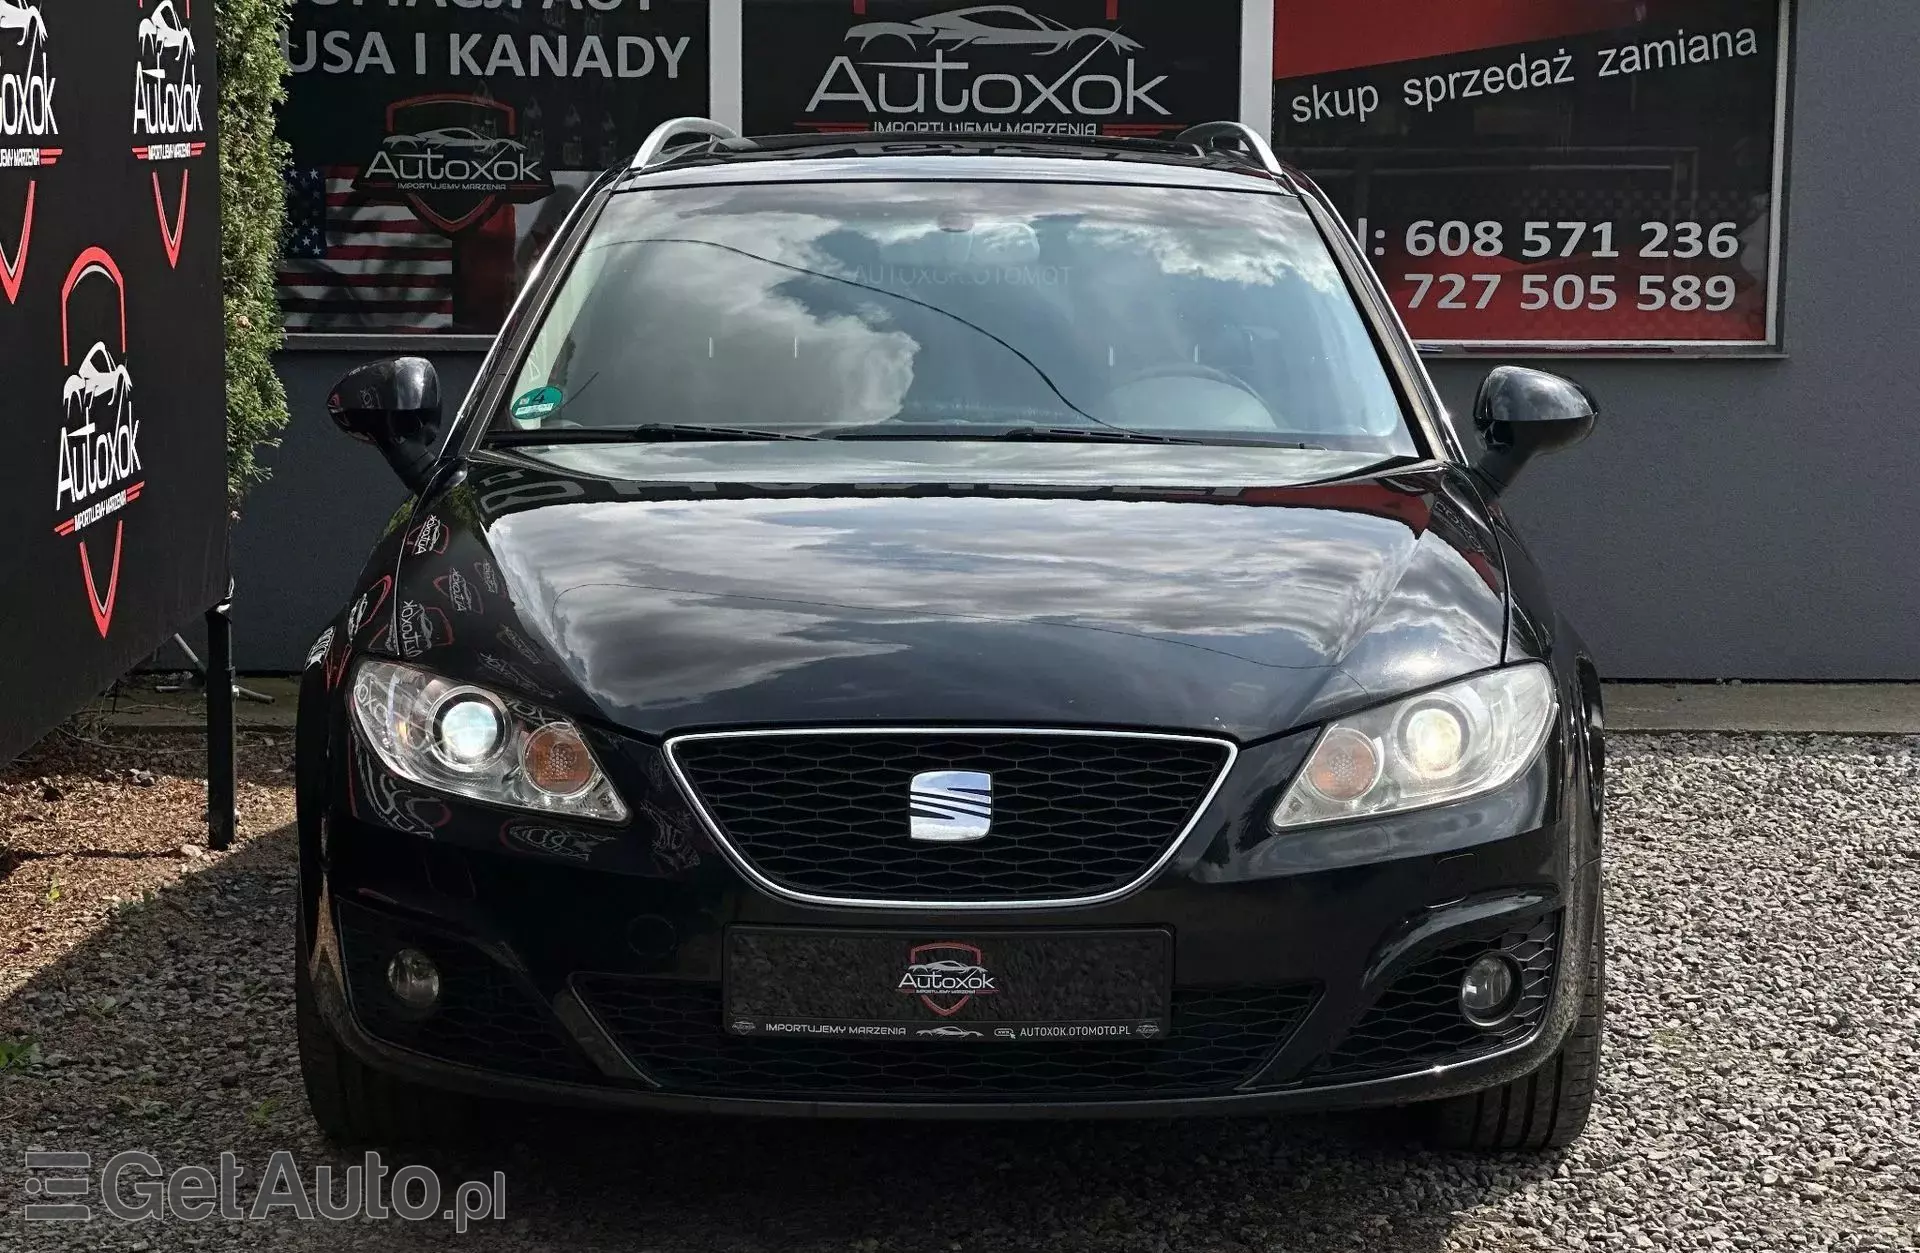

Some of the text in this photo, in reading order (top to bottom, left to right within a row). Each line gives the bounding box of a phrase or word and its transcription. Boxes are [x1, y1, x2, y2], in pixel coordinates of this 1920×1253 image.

[282, 30, 691, 79] USA I KANADY
[0, 50, 58, 135] oxok
[133, 54, 204, 134] Autoxok
[805, 46, 1173, 115] Autoxok
[1292, 28, 1758, 123] skup sprzedaż zamiana
[364, 145, 543, 182] Autoxok
[397, 182, 507, 191] IMPORTUJEMY MARZENIA
[1404, 219, 1504, 258] 608
[1521, 220, 1619, 259] 571
[1638, 220, 1740, 259] 236
[1403, 273, 1737, 312] 727 505 589
[56, 403, 142, 511] Autoxok
[898, 970, 996, 989] Autoxok
[765, 1022, 847, 1035] IMPORTUJEMY
[848, 1025, 907, 1037] MARZENIA
[1019, 1025, 1132, 1038] AUTOXOK.OTOMOTO.PL
